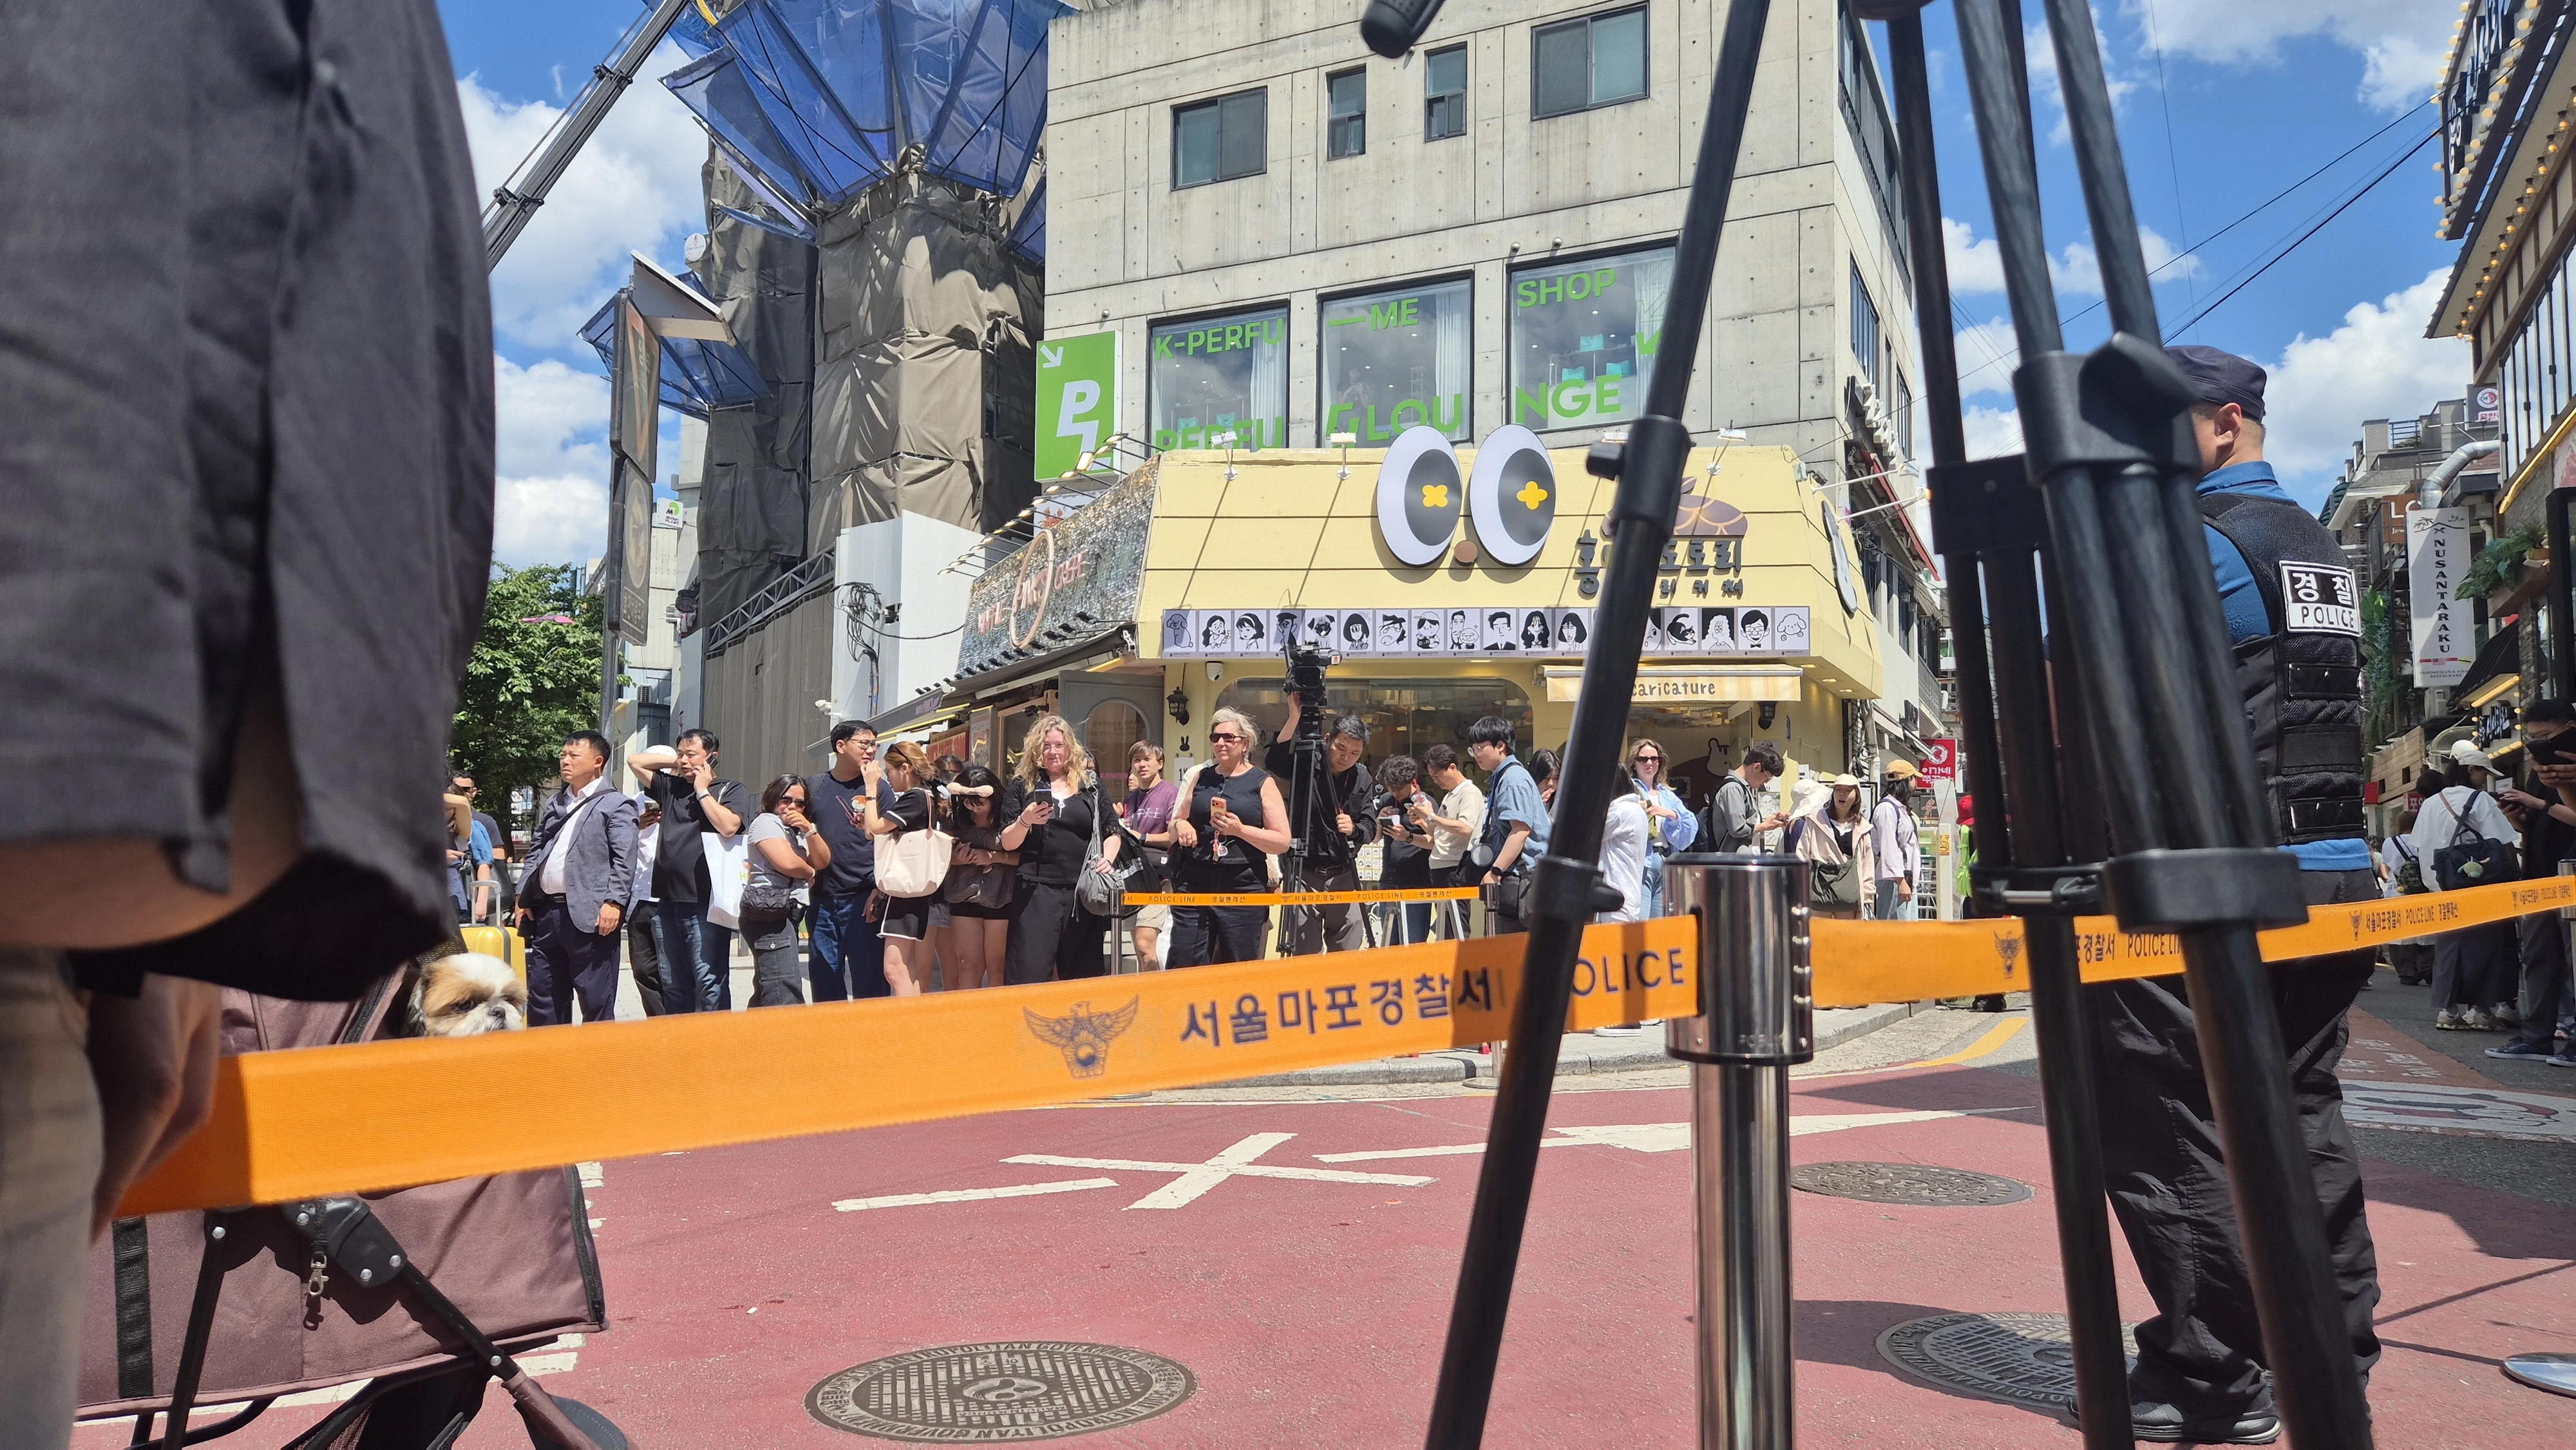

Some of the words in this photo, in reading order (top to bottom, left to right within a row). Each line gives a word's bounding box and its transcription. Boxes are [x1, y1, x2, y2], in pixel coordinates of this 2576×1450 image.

[1155, 317, 1285, 361] K-PERFU
[1517, 268, 1616, 308] SHOP
[2433, 538, 2451, 654] NUSANTARAKU
[2300, 605, 2354, 629] POLICE
[1632, 680, 1716, 697] caricature
[1922, 766, 1951, 775] 이가네
[2405, 907, 2424, 925] POLICE
[2425, 905, 2434, 922] LINE
[2127, 933, 2165, 958] POLICE
[1570, 947, 1685, 997] OLICE
[1180, 966, 1493, 1048] 서울마포경찰서
